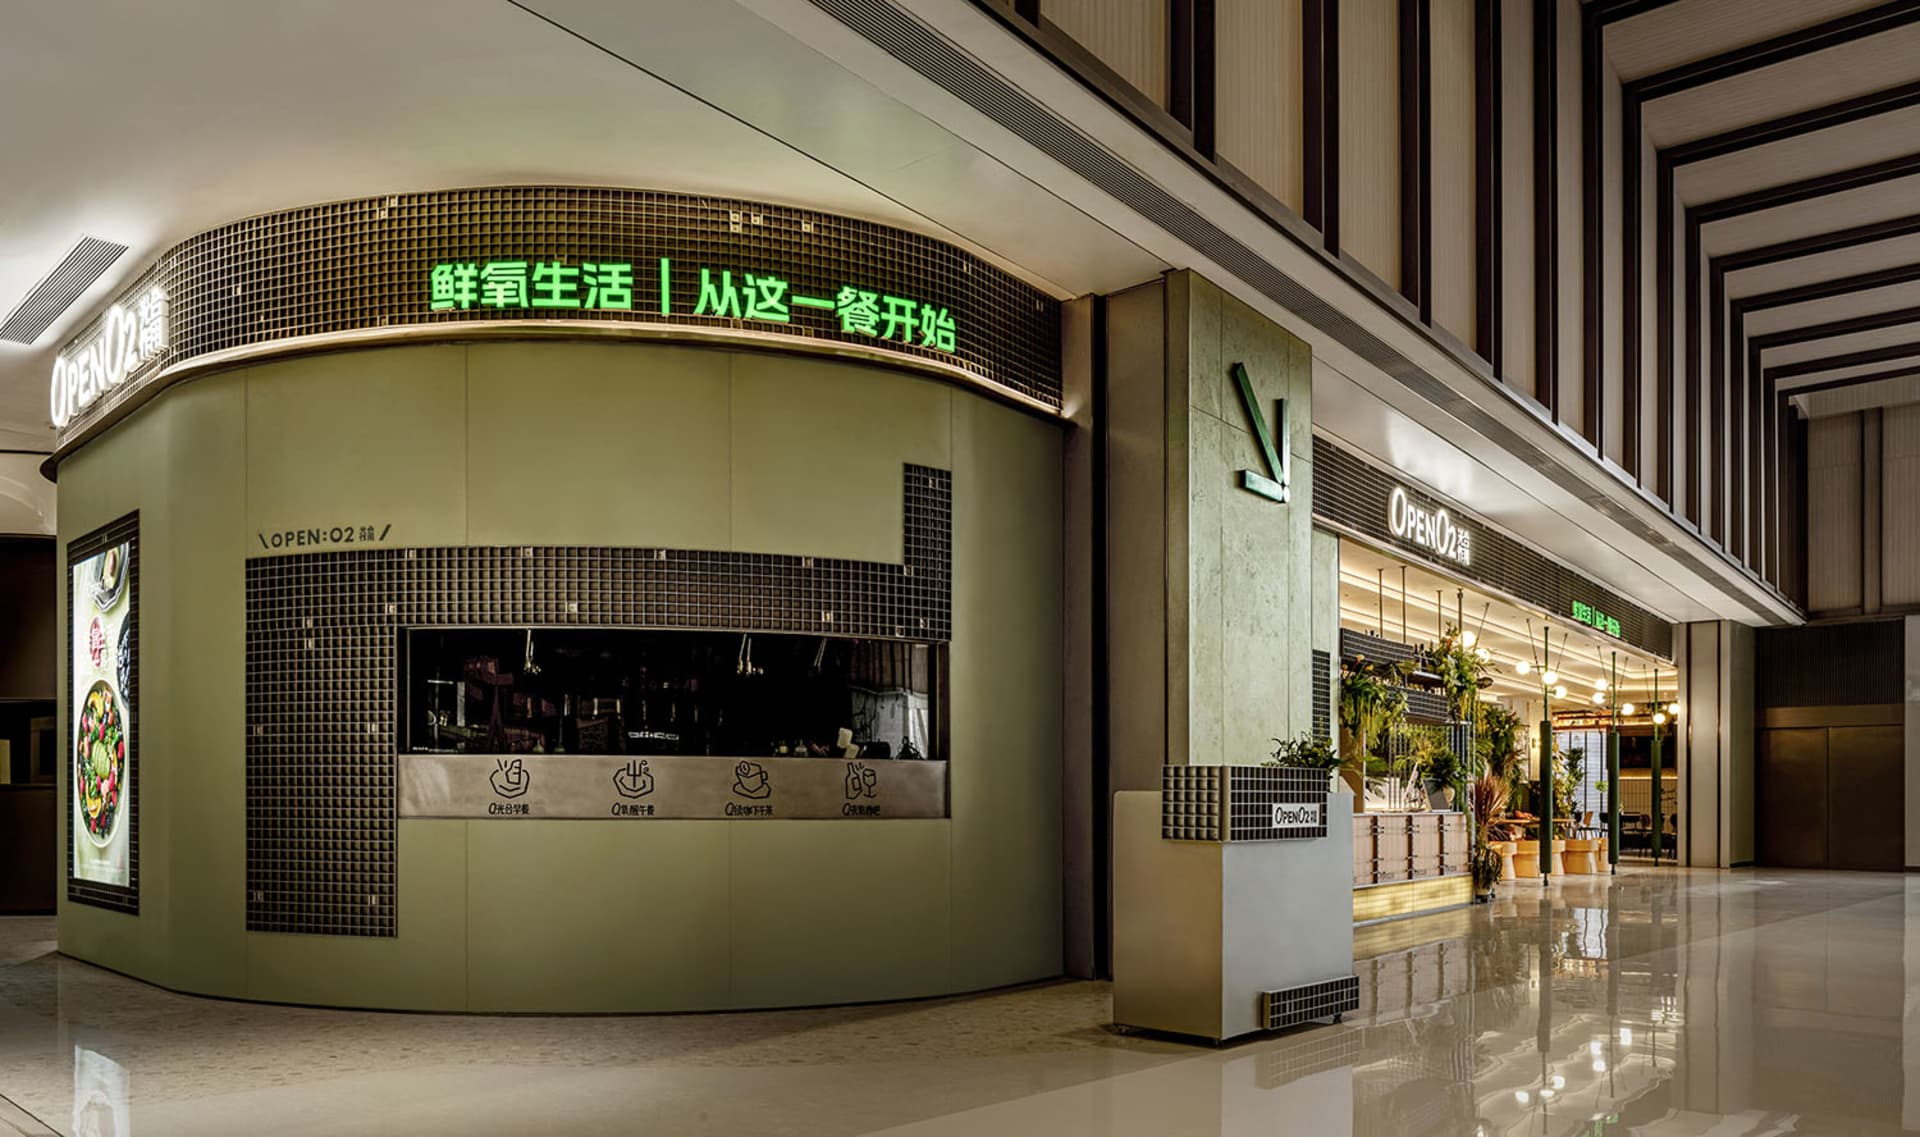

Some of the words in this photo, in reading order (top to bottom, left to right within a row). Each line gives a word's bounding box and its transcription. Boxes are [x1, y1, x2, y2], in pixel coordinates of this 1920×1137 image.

[431, 261, 634, 309] 鲜氧生活
[693, 268, 956, 352] 从这一餐开始
